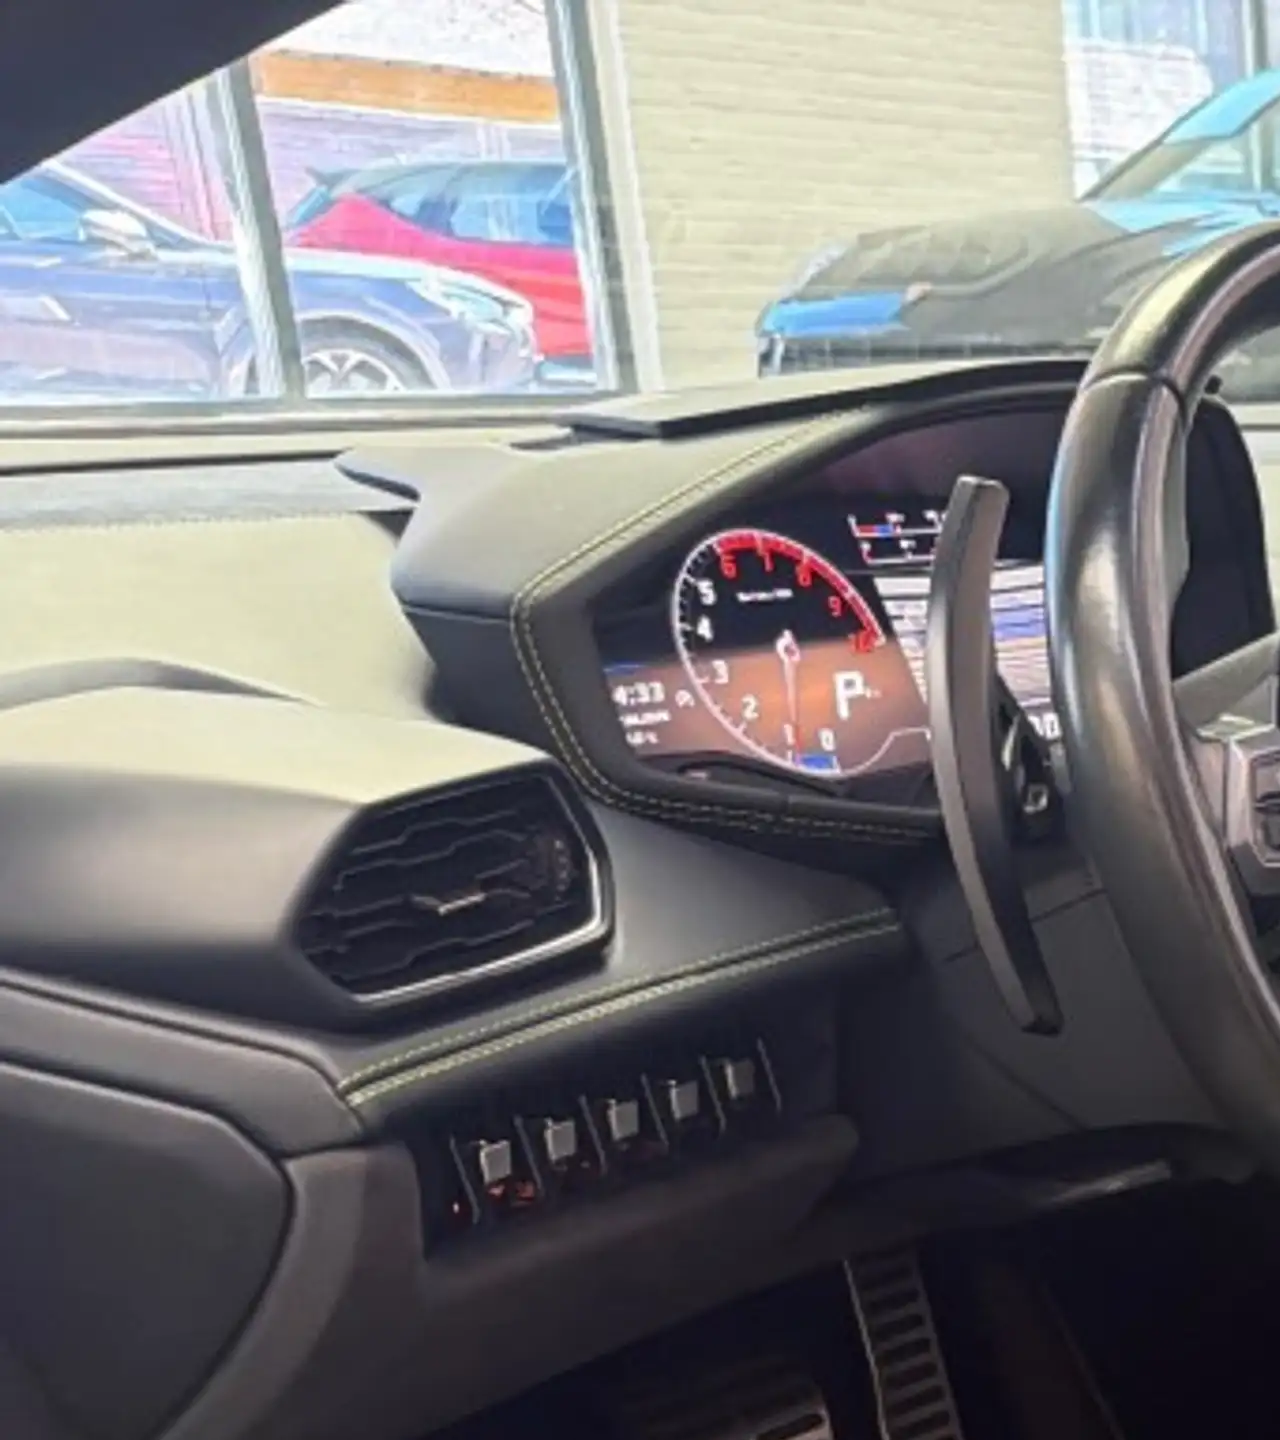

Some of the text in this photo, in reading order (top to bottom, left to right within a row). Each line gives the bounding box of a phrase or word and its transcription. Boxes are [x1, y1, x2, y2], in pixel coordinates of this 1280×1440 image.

[721, 552, 737, 579] 6
[699, 579, 717, 606] 5
[828, 595, 843, 618] 9
[697, 615, 714, 642] 4
[711, 660, 729, 684] 3
[740, 693, 760, 721] 2
[833, 670, 865, 722] P
[783, 723, 795, 747] 1
[818, 726, 836, 752] 0
